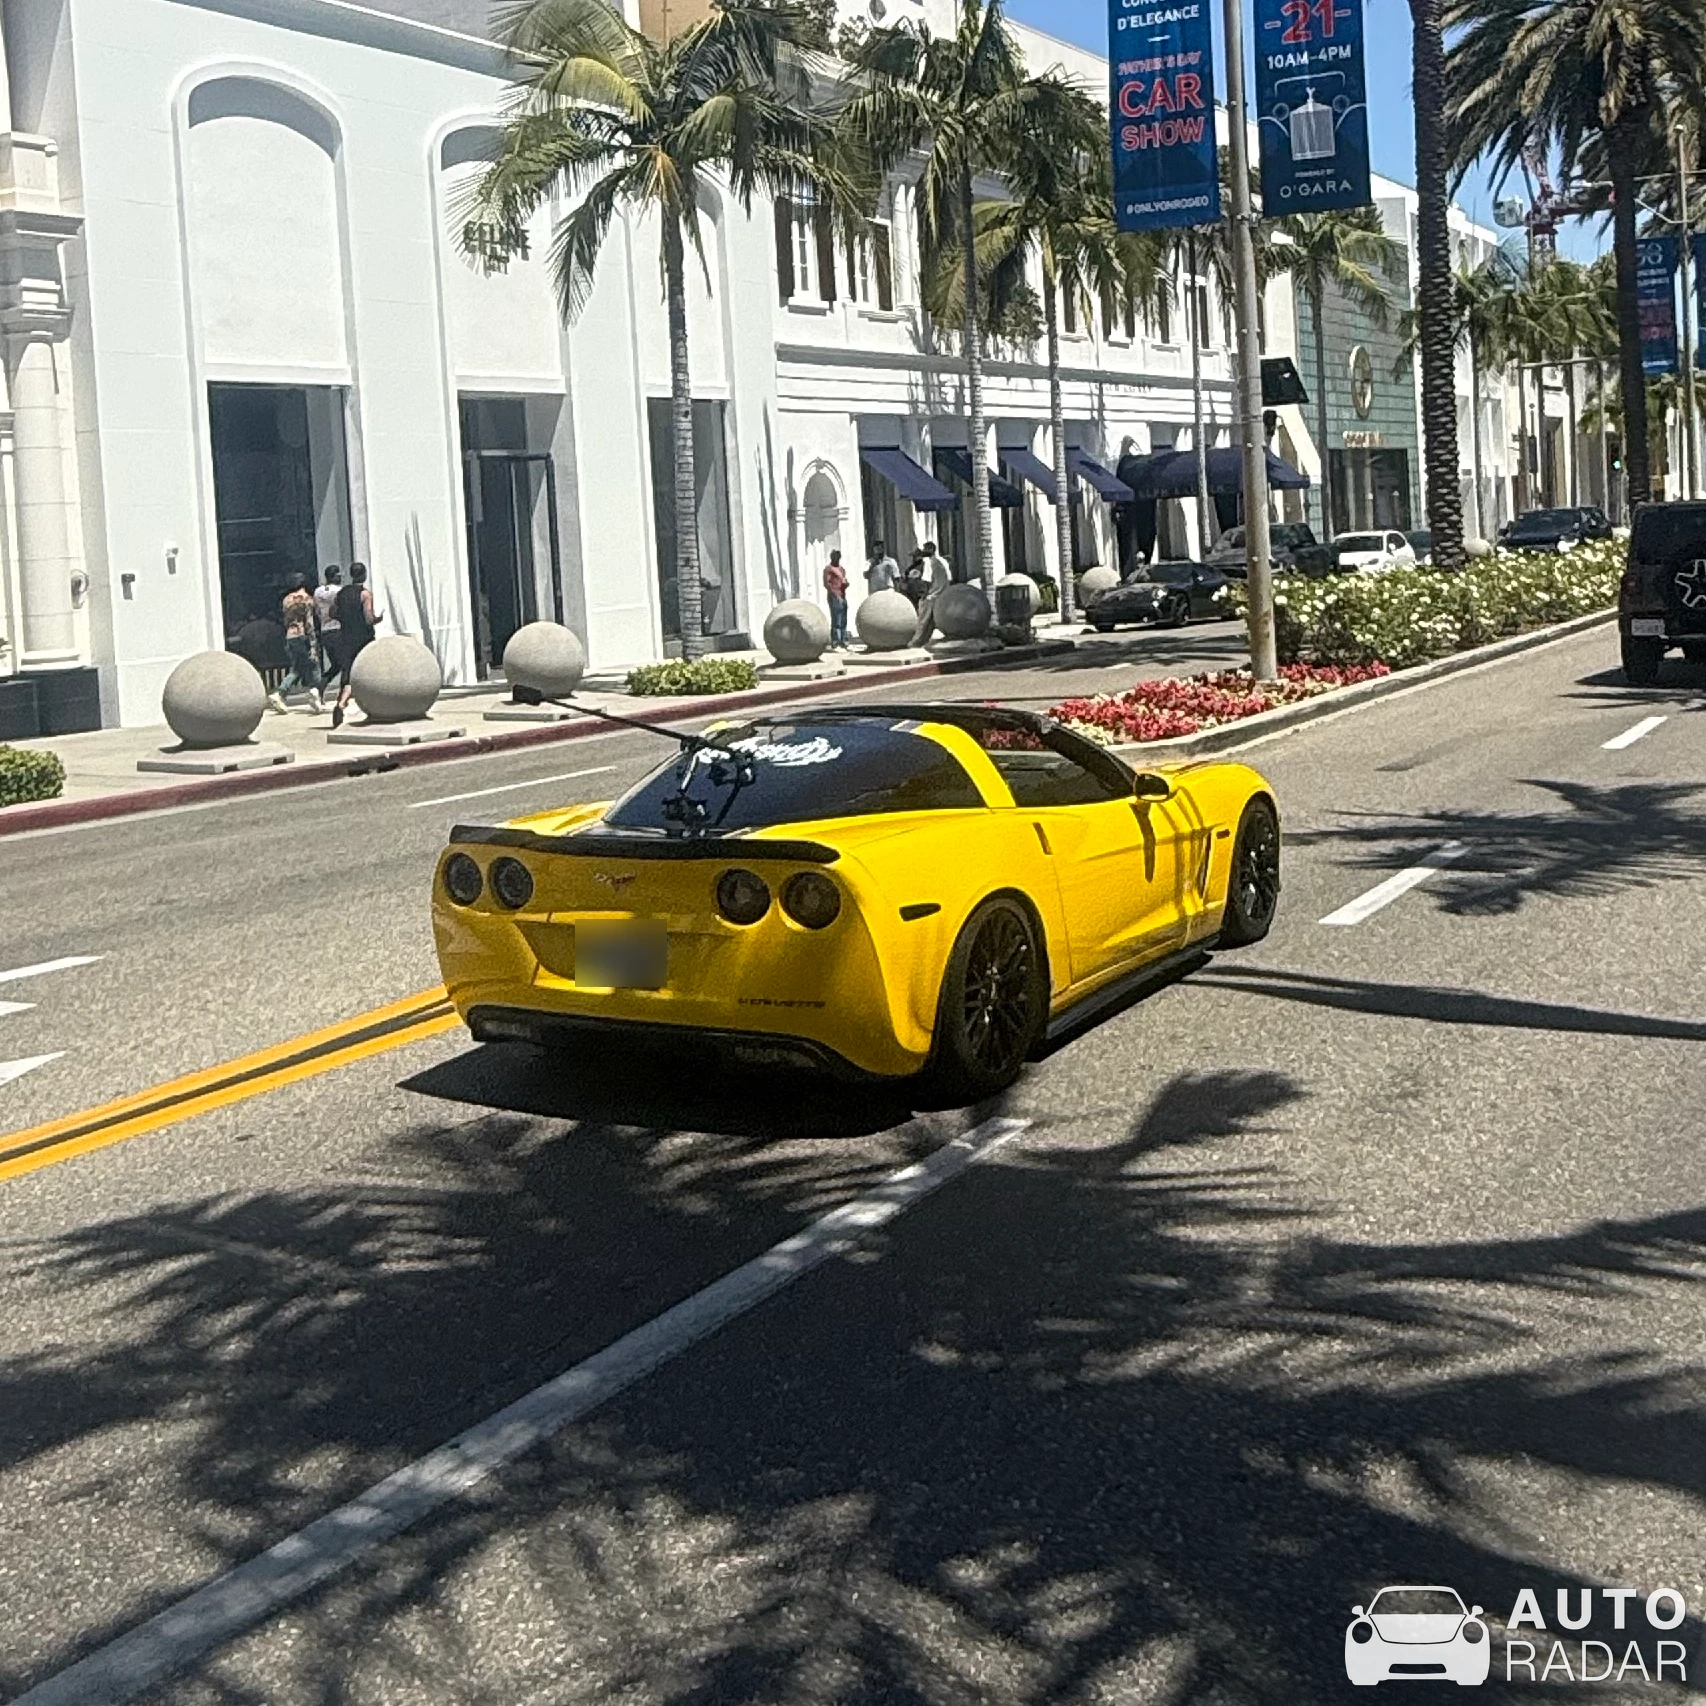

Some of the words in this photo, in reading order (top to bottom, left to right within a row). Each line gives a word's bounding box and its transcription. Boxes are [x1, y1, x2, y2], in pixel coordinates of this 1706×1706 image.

[1117, 4, 1200, 31] D'ELEGANCE
[1118, 73, 1204, 118] CAR
[1121, 116, 1205, 151] SHOW
[1280, 179, 1353, 198] O'GARA
